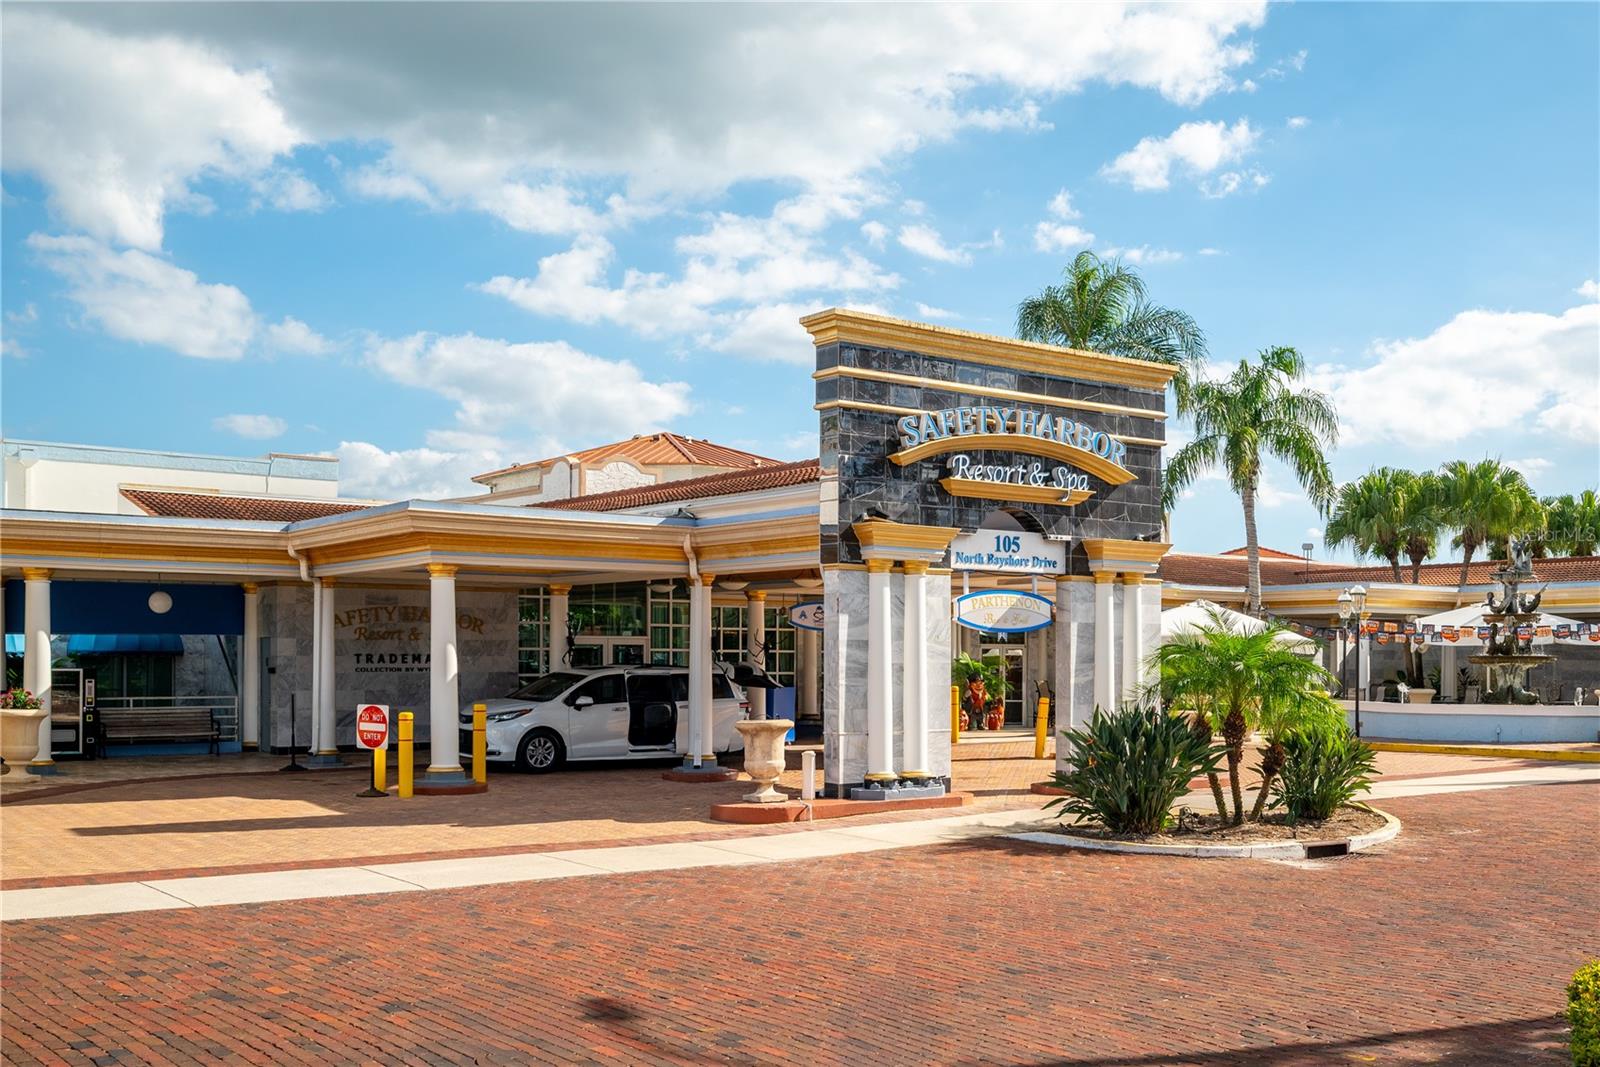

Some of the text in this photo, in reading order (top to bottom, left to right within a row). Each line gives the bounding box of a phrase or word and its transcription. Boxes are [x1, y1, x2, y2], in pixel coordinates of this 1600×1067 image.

[898, 406, 1127, 468] SAFETY HARBOR
[949, 455, 1090, 502] Resort & Spa
[994, 535, 1021, 553] 105
[955, 551, 1058, 569] North Bayshore Drive
[971, 596, 1041, 610] PARTHENON
[334, 606, 485, 635] AFETY HAOR
[354, 626, 424, 641] Resort &
[354, 653, 431, 665] TRADEMA
[361, 713, 384, 722] DO NOT
[363, 732, 381, 740] ENTER
